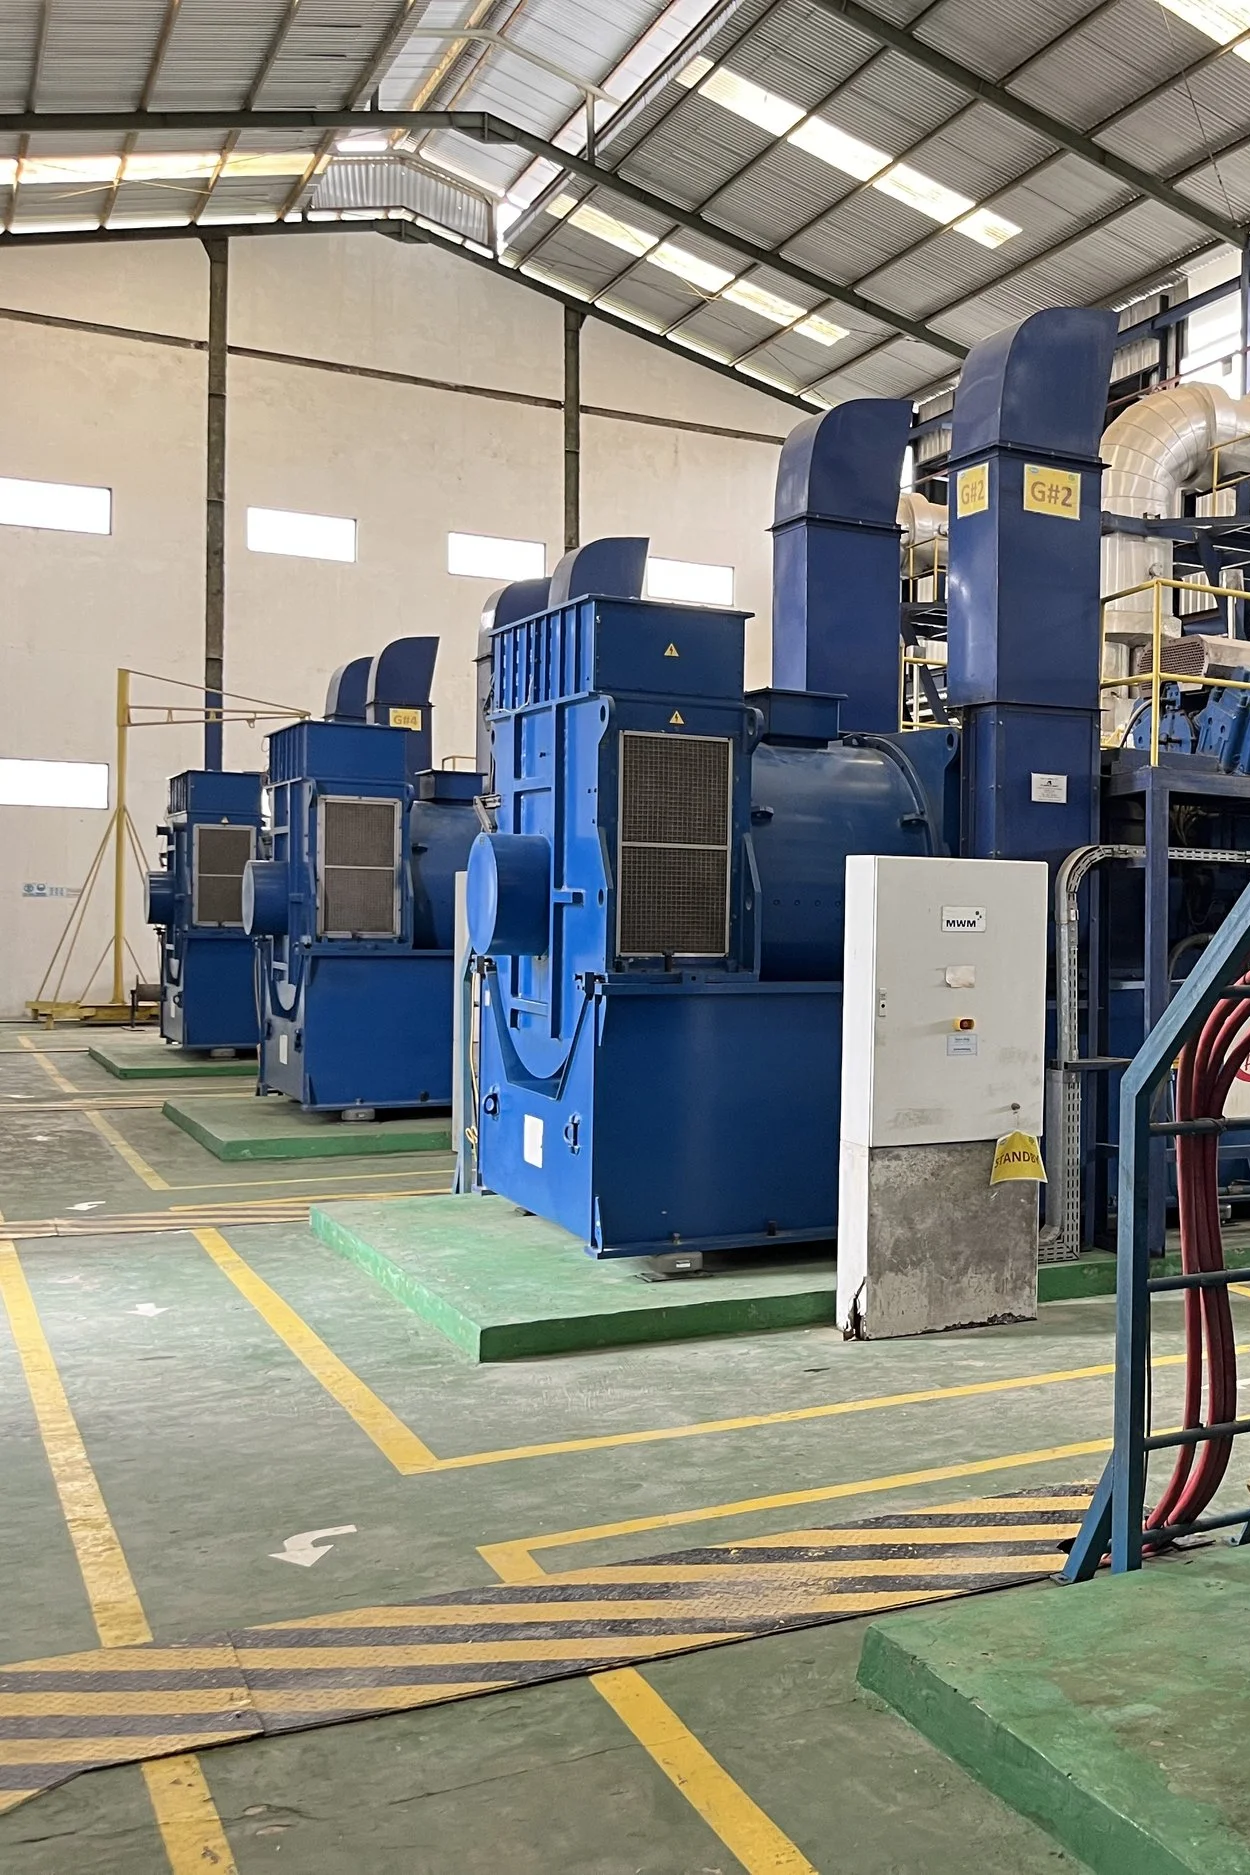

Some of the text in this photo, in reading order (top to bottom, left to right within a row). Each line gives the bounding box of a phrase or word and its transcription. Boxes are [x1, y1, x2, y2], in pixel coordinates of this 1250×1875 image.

[961, 480, 985, 505] G#2
[1030, 480, 1073, 508] G#2
[393, 715, 417, 725] G#4
[946, 919, 977, 928] MWM
[994, 1150, 1040, 1169] STANDBY
